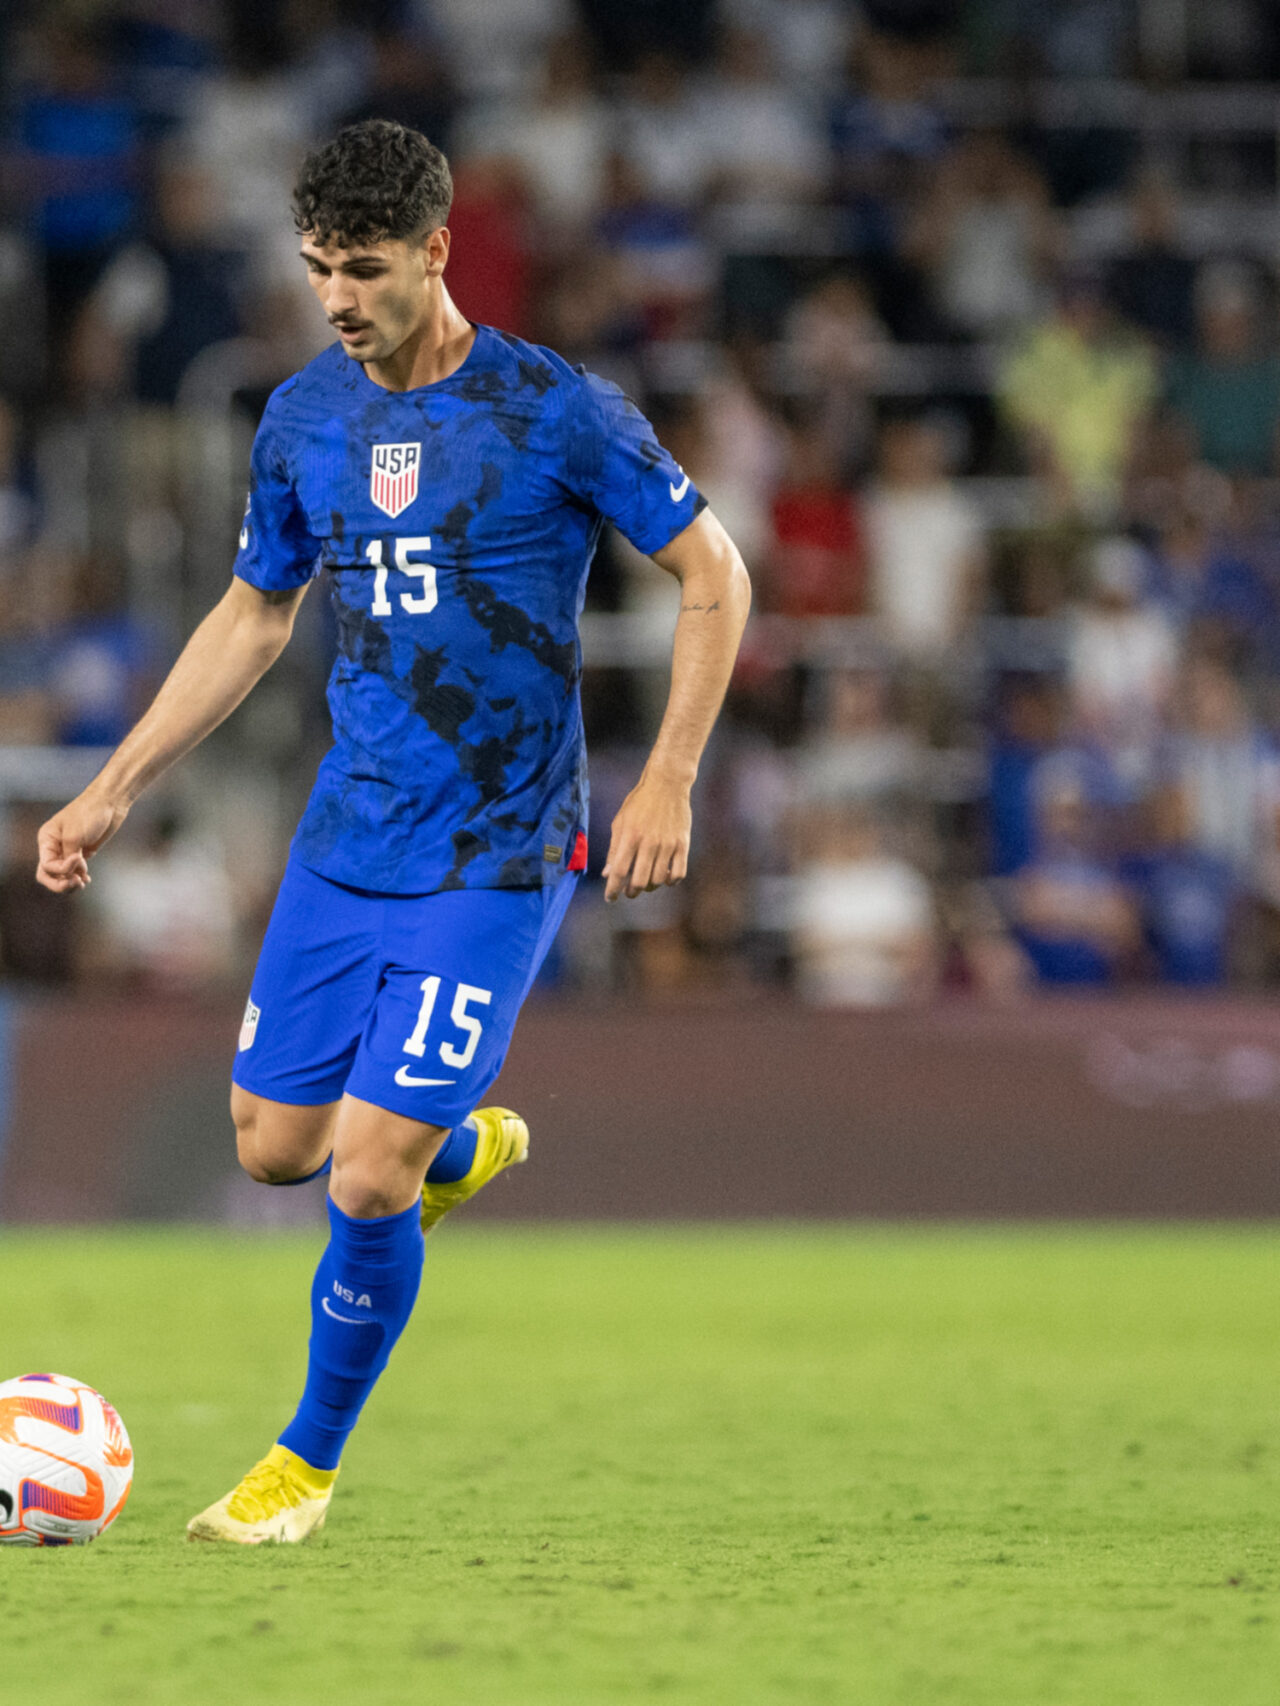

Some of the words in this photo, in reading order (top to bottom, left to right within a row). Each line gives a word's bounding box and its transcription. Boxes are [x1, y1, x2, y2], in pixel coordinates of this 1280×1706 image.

[376, 447, 417, 475] USA
[366, 536, 438, 616] 15
[402, 975, 492, 1070] 15
[333, 1279, 372, 1308] USA
